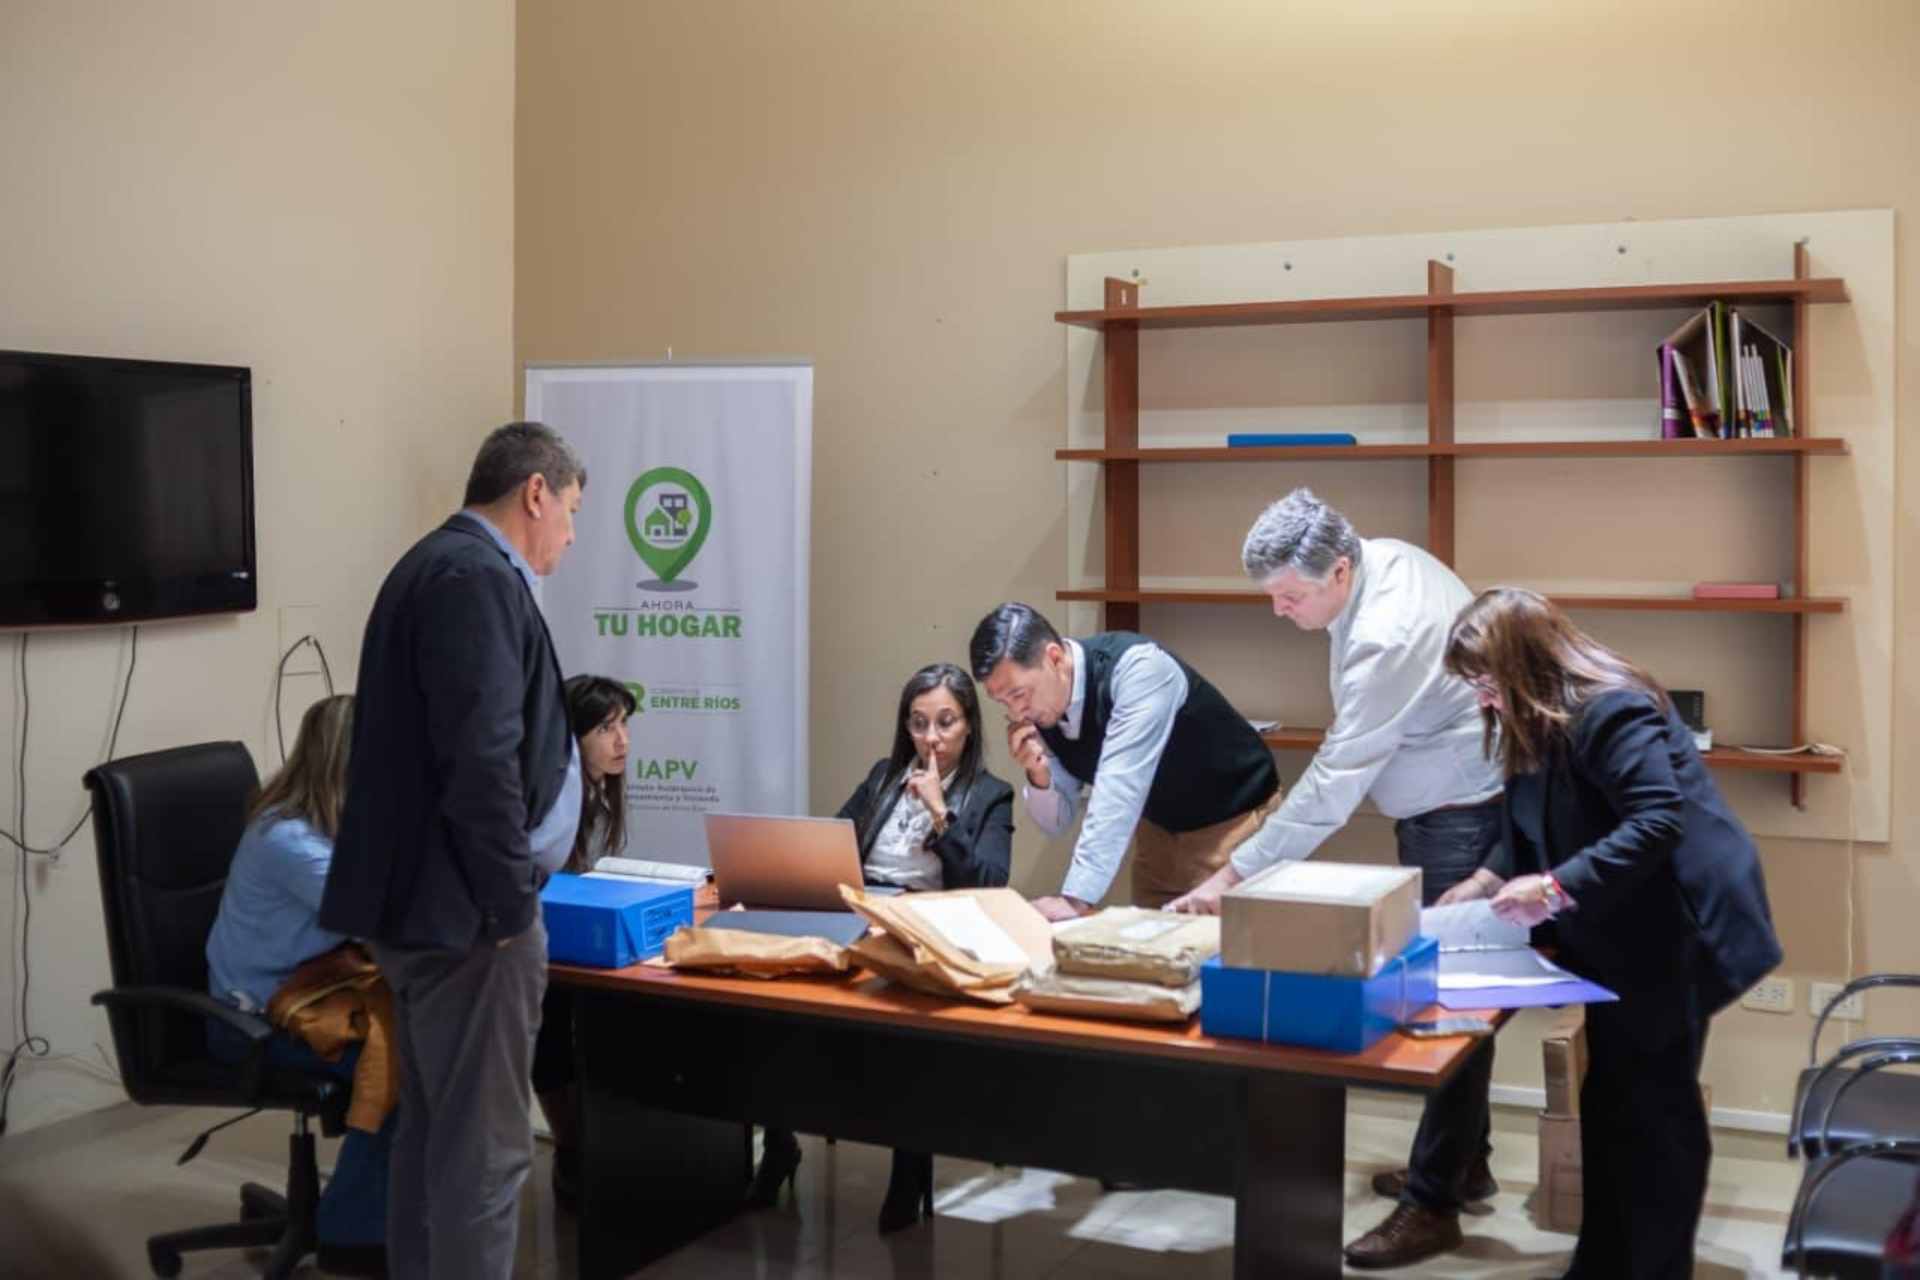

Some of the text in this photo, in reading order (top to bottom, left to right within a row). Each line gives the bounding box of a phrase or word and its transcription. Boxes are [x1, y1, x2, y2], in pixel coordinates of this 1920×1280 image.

[640, 600, 695, 611] AHORA
[594, 613, 742, 638] TU HOGAR
[650, 695, 742, 710] ENTRE RÍOS
[637, 758, 699, 780] IAPV
